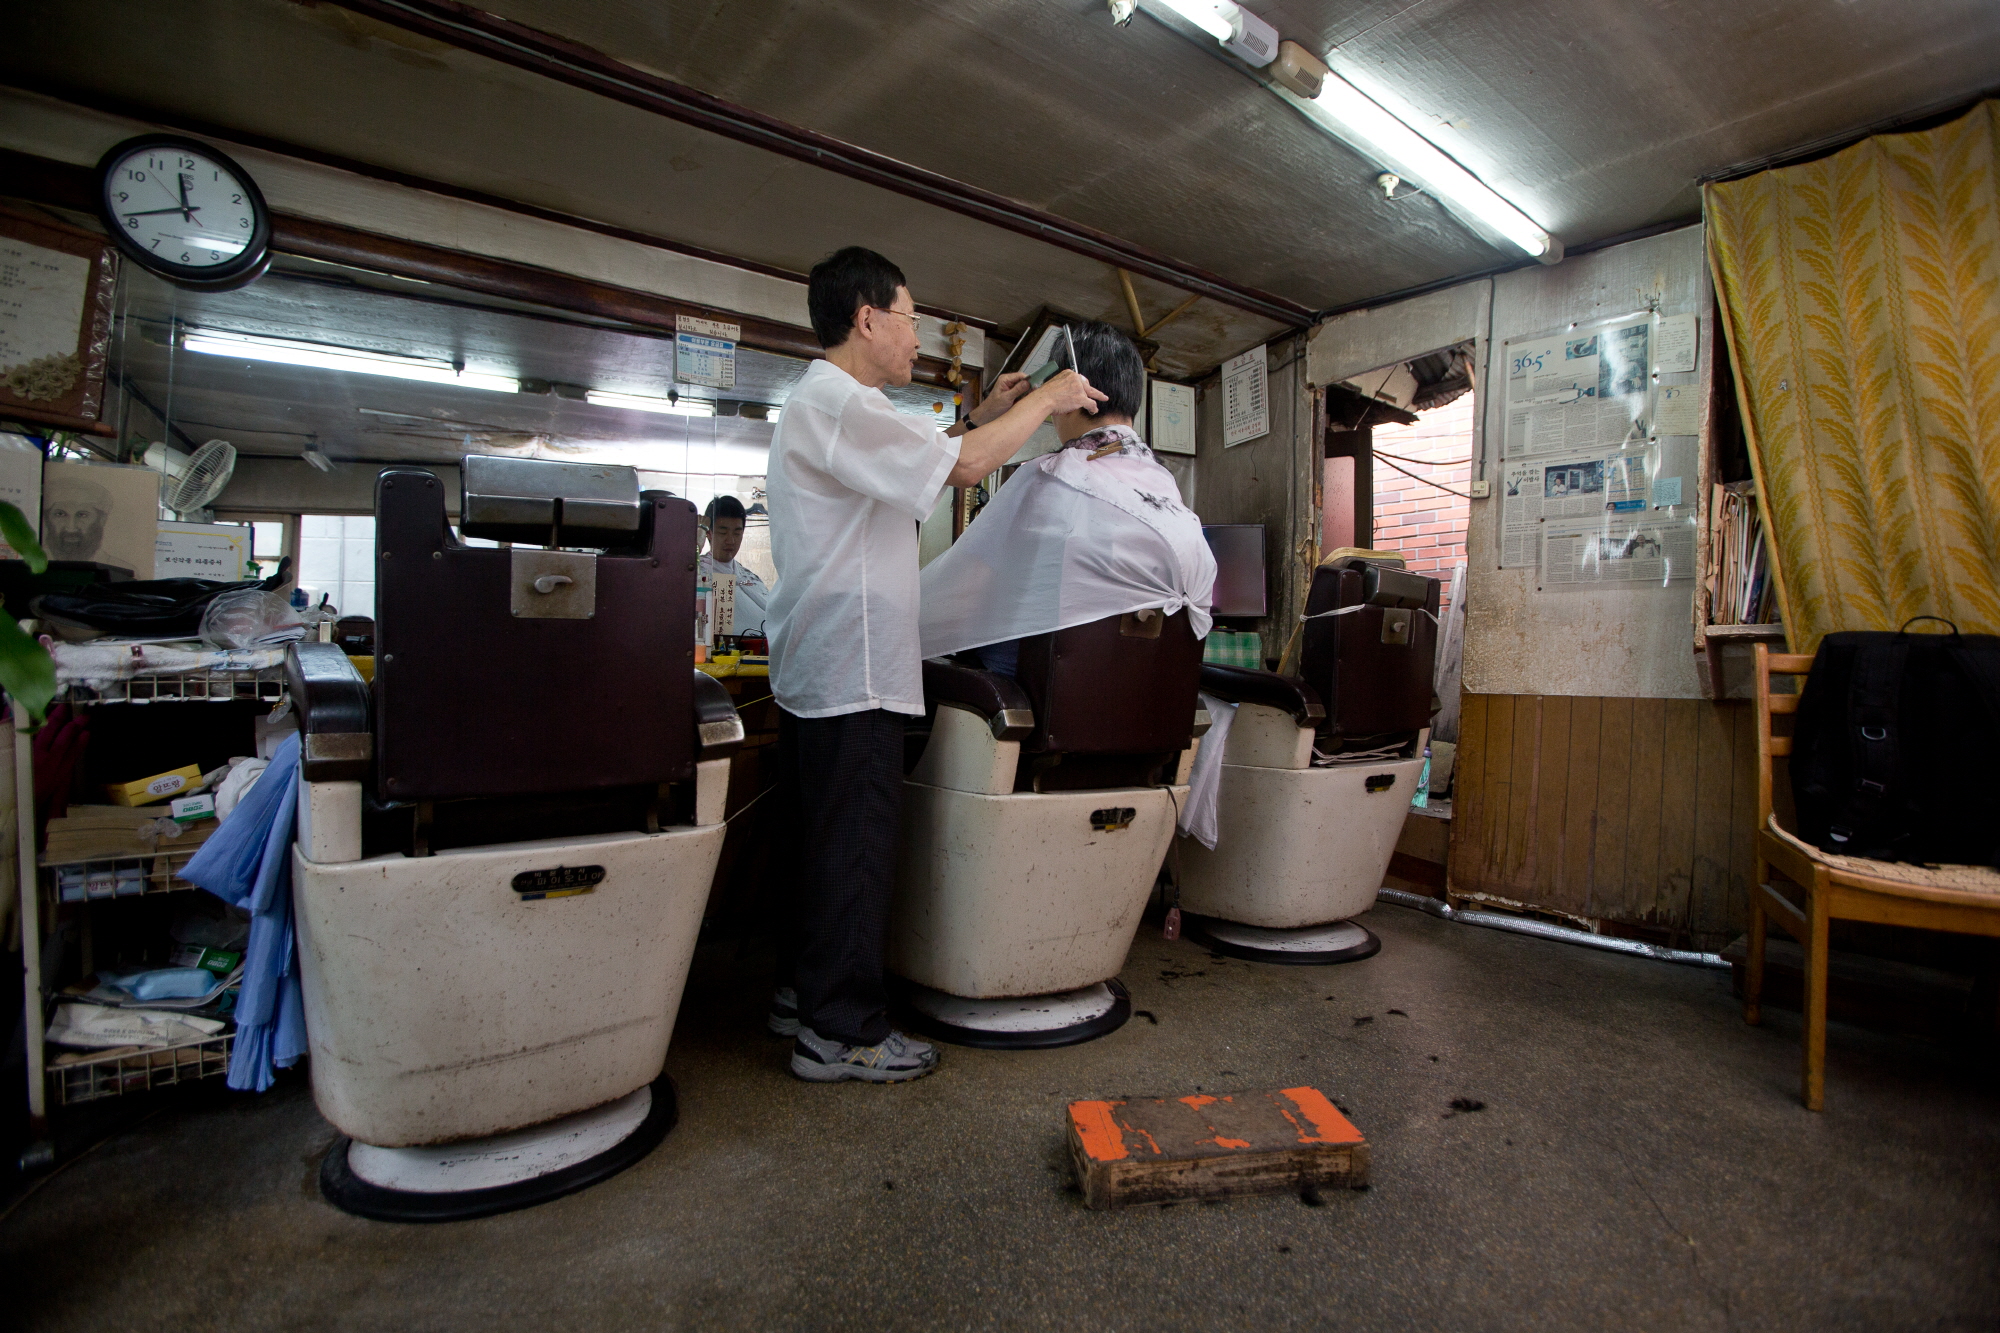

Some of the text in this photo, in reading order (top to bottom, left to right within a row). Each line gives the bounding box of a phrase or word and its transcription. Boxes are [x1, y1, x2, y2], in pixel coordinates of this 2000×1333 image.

[150, 157, 163, 170] 11
[179, 157, 195, 171] 12
[129, 170, 146, 182] 10
[119, 192, 129, 202] 9
[232, 194, 242, 205] 2
[128, 218, 139, 229] 8
[239, 217, 249, 228] 3
[151, 238, 161, 249] 7
[180, 251, 190, 262] 6
[210, 251, 220, 261] 5
[1523, 475, 1540, 483] 이발사
[152, 777, 182, 794] 알뜨랑
[182, 804, 204, 813] 2080
